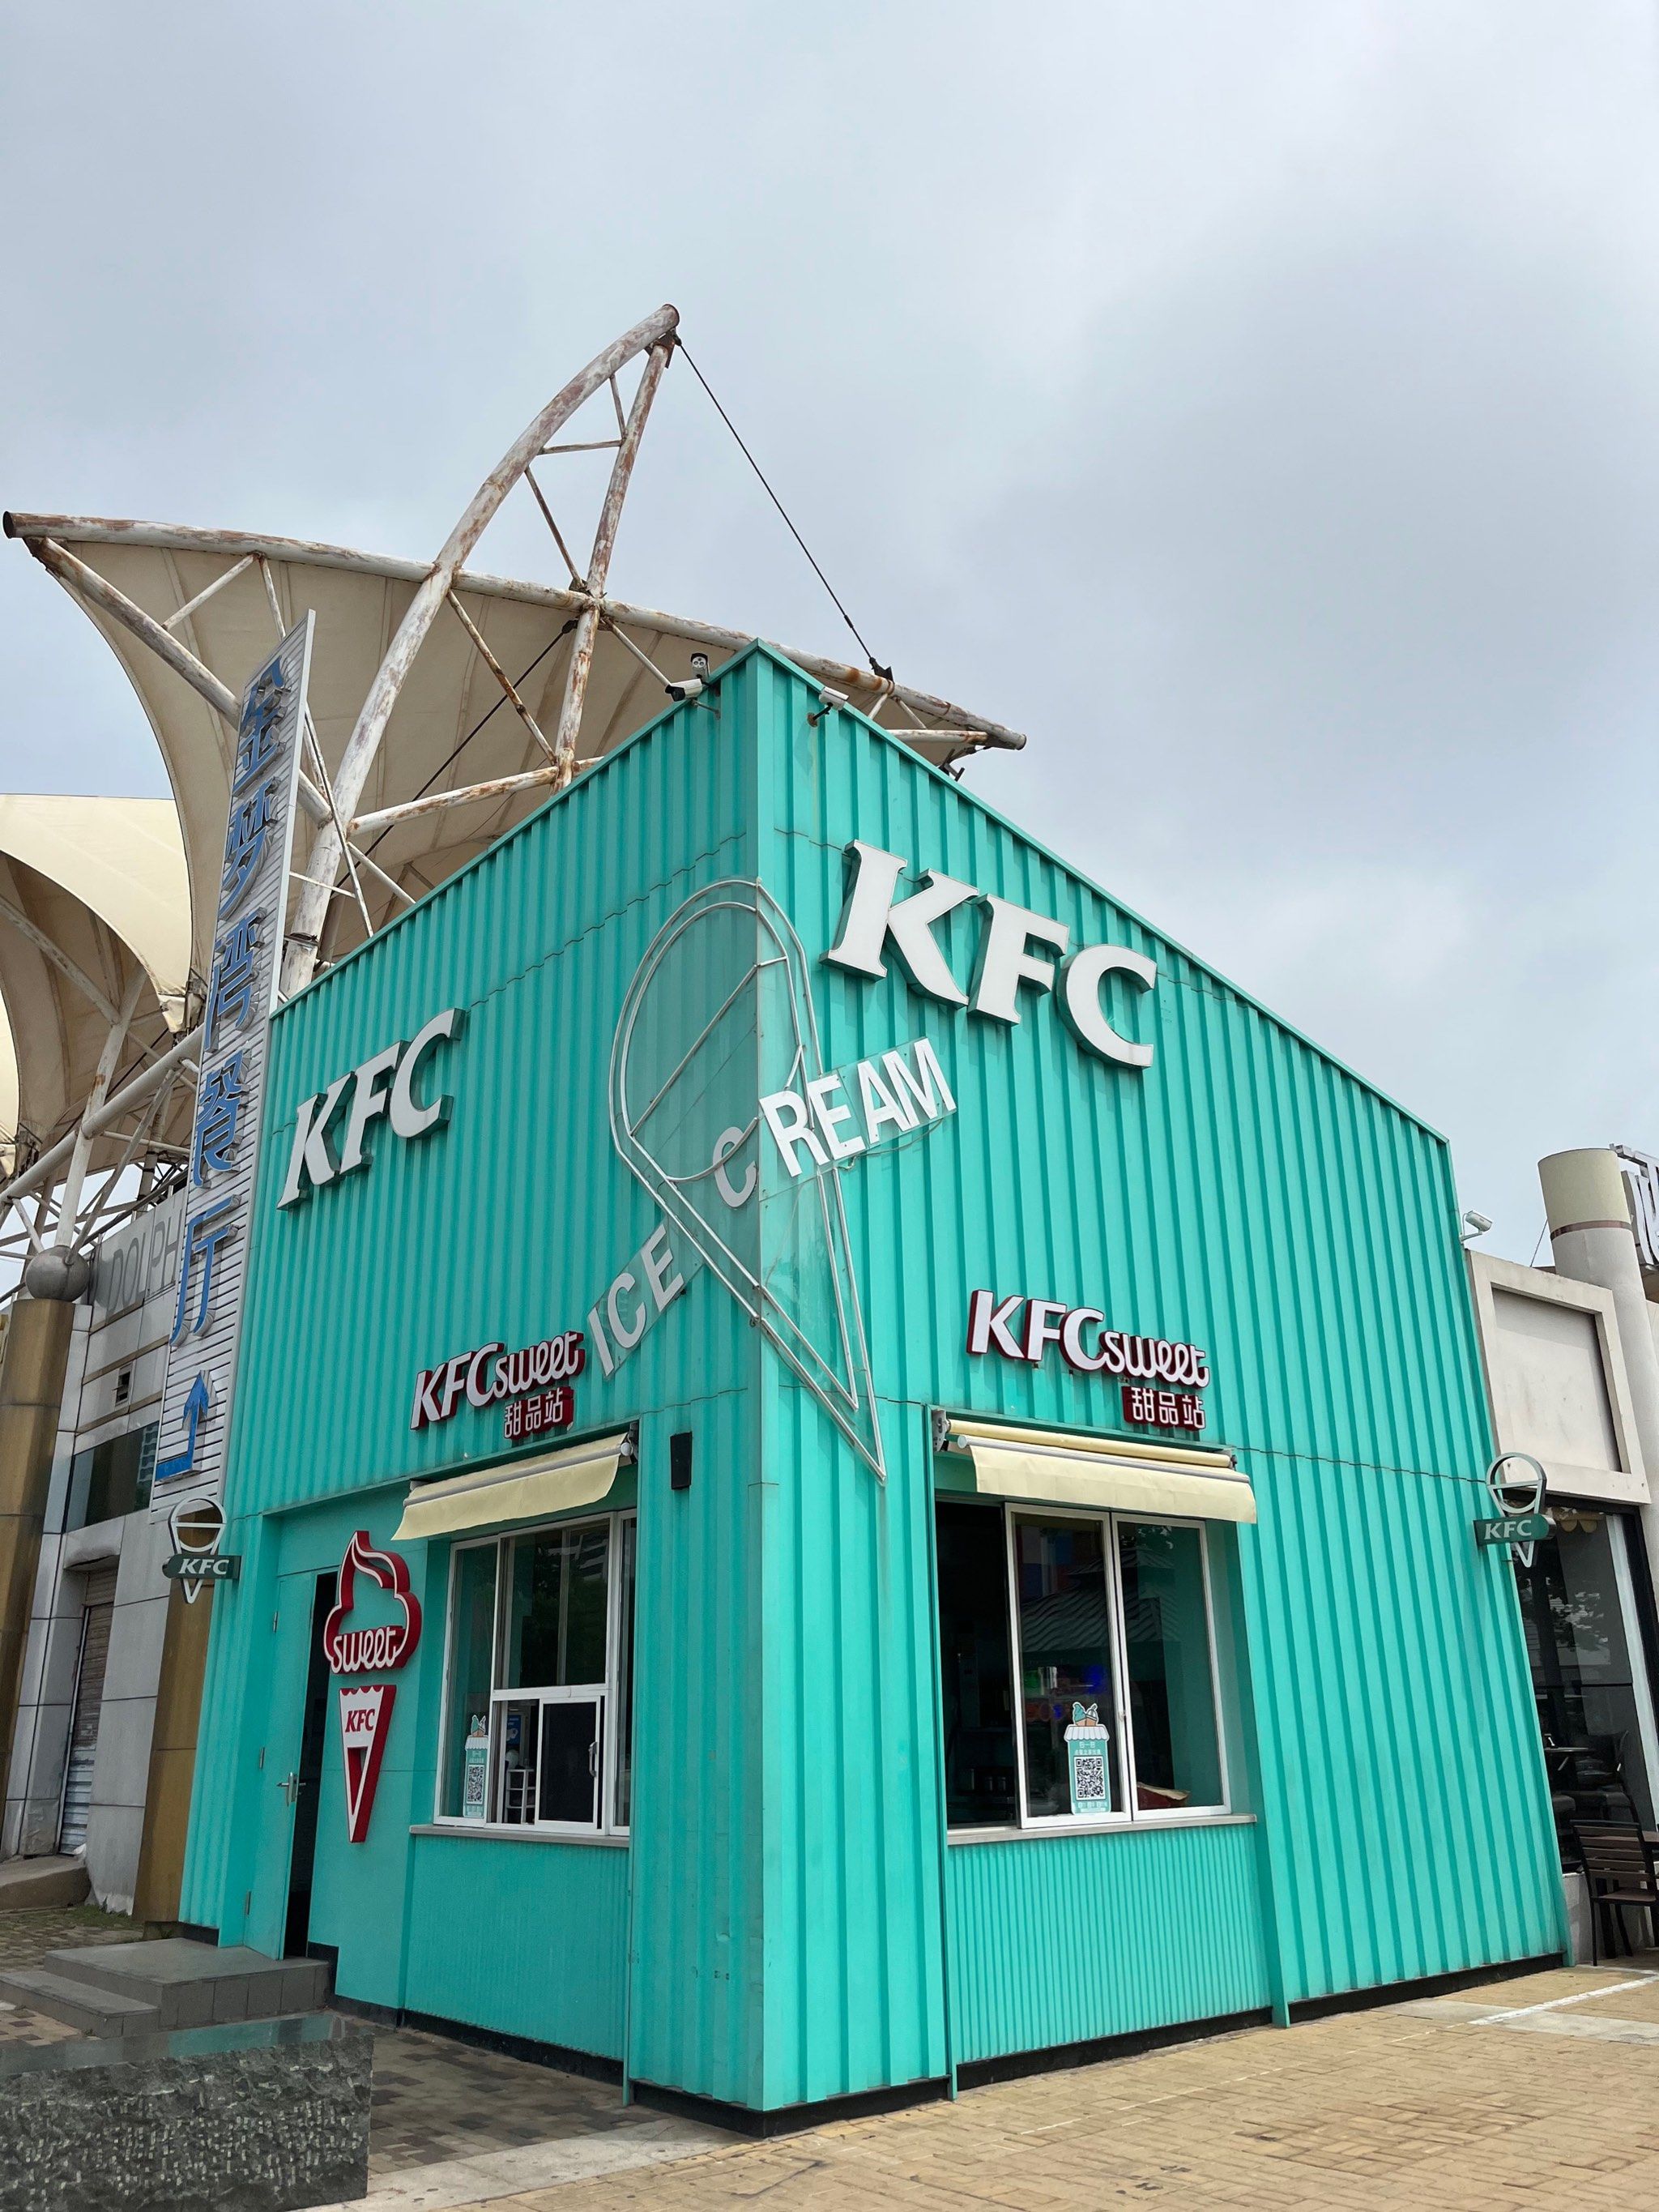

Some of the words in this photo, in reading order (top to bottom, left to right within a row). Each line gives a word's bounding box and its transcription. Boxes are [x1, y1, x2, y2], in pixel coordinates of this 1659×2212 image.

[820, 839, 1158, 1070] KFC
[169, 655, 286, 1347] 金梦湾餐厅
[276, 1008, 467, 1211] KFC
[586, 1223, 684, 1377] ICE
[503, 1387, 574, 1440] 甜品站
[1122, 1386, 1206, 1431] 甜品站
[1483, 1519, 1532, 1540] KFC
[178, 1558, 229, 1575] KFC
[331, 1626, 401, 1674] sweet
[345, 1709, 375, 1733] KFC
